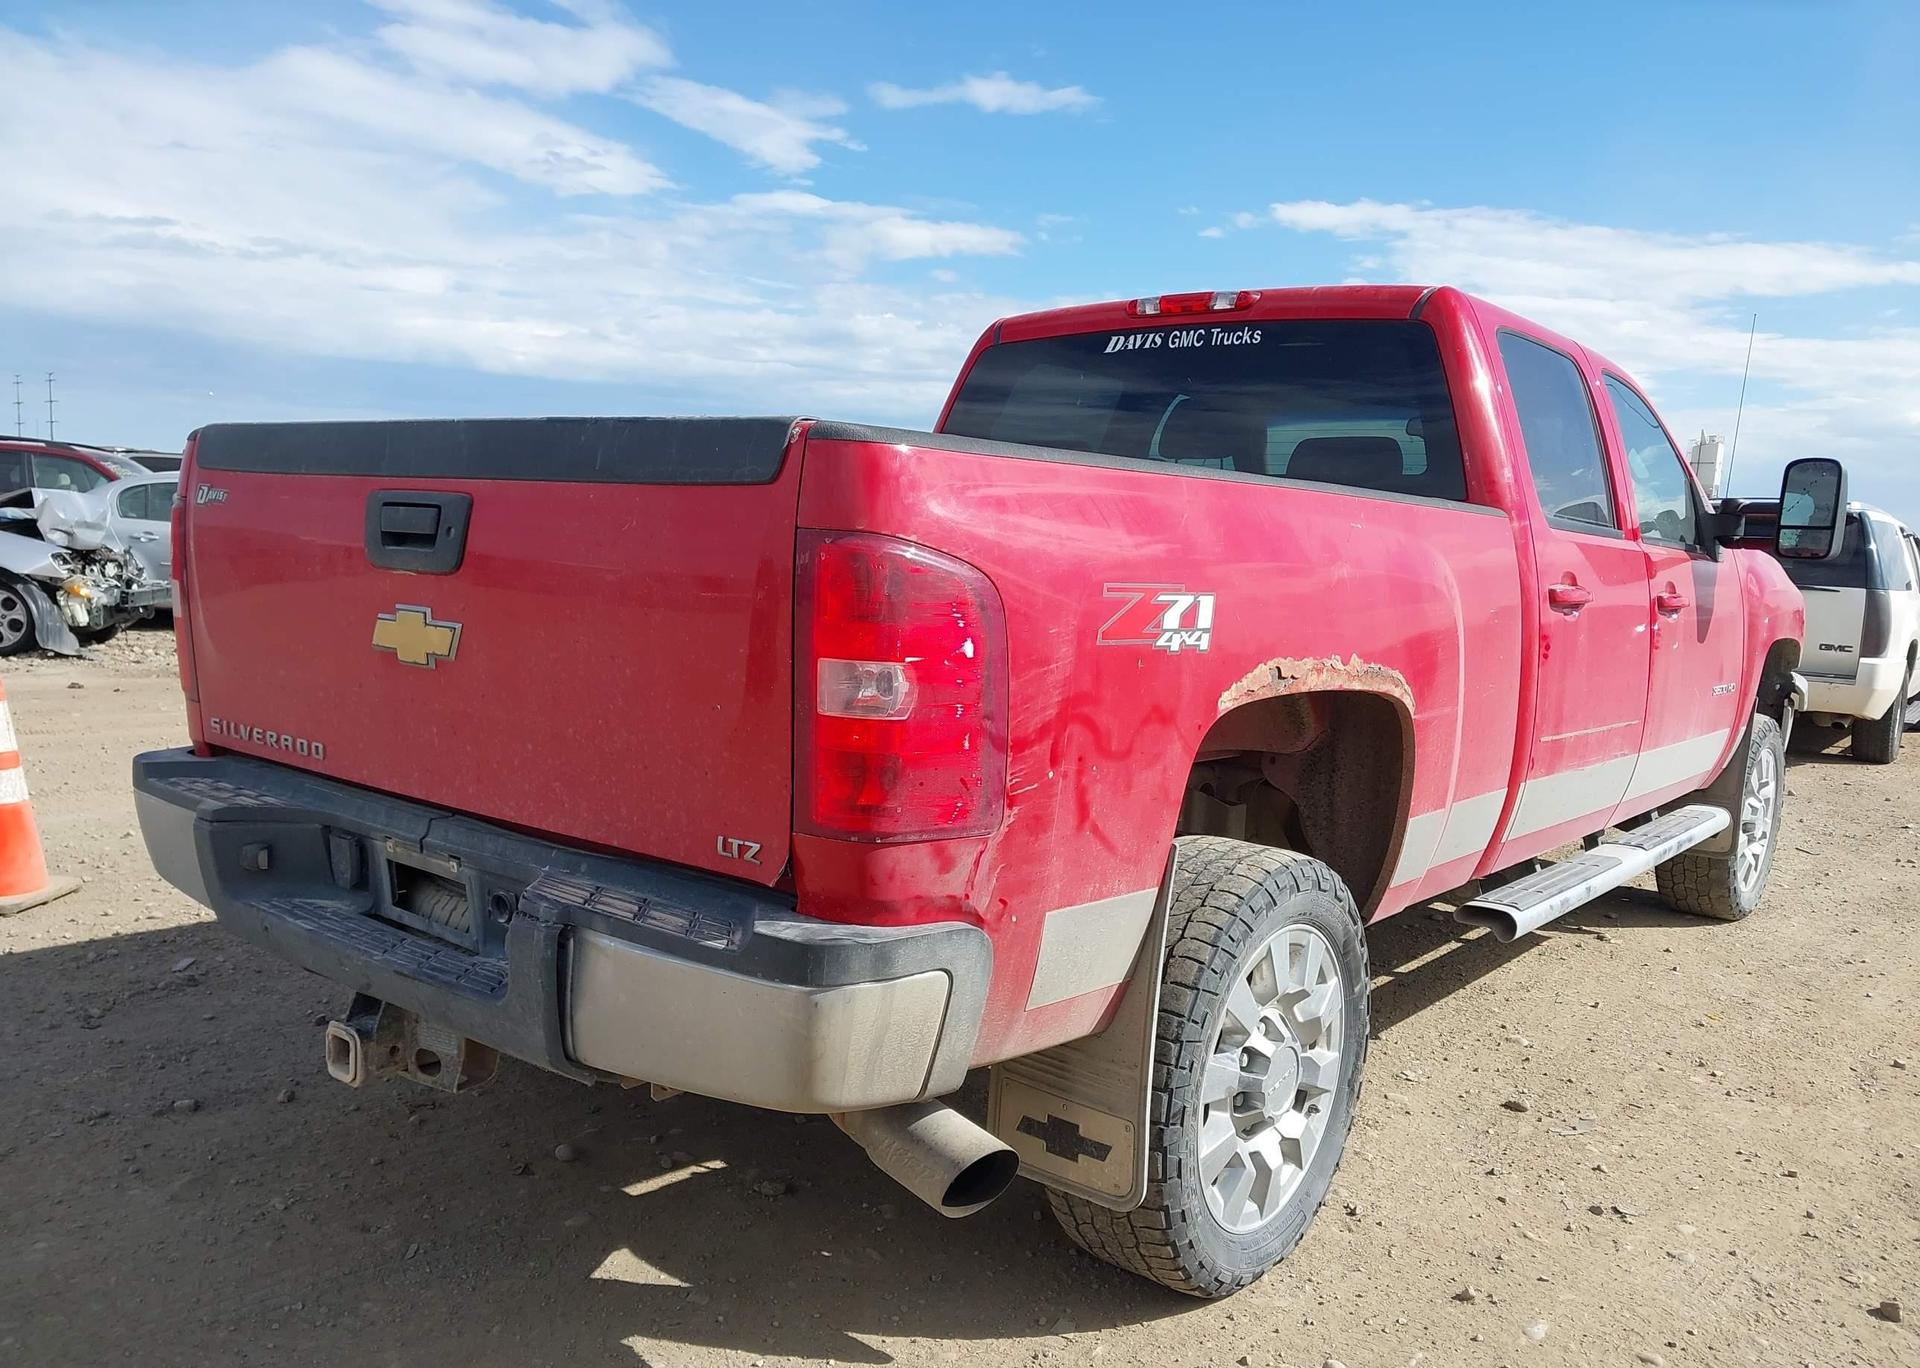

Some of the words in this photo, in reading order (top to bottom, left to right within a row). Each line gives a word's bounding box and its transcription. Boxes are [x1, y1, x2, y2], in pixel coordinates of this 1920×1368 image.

[1103, 332, 1165, 354] DAVIS
[1168, 329, 1206, 349] GMC
[1210, 326, 1263, 346] Trucks
[1096, 582, 1217, 646] Z71
[1818, 643, 1854, 653] GMC
[210, 717, 326, 761] SILVERADO
[717, 835, 762, 865] LTZ
